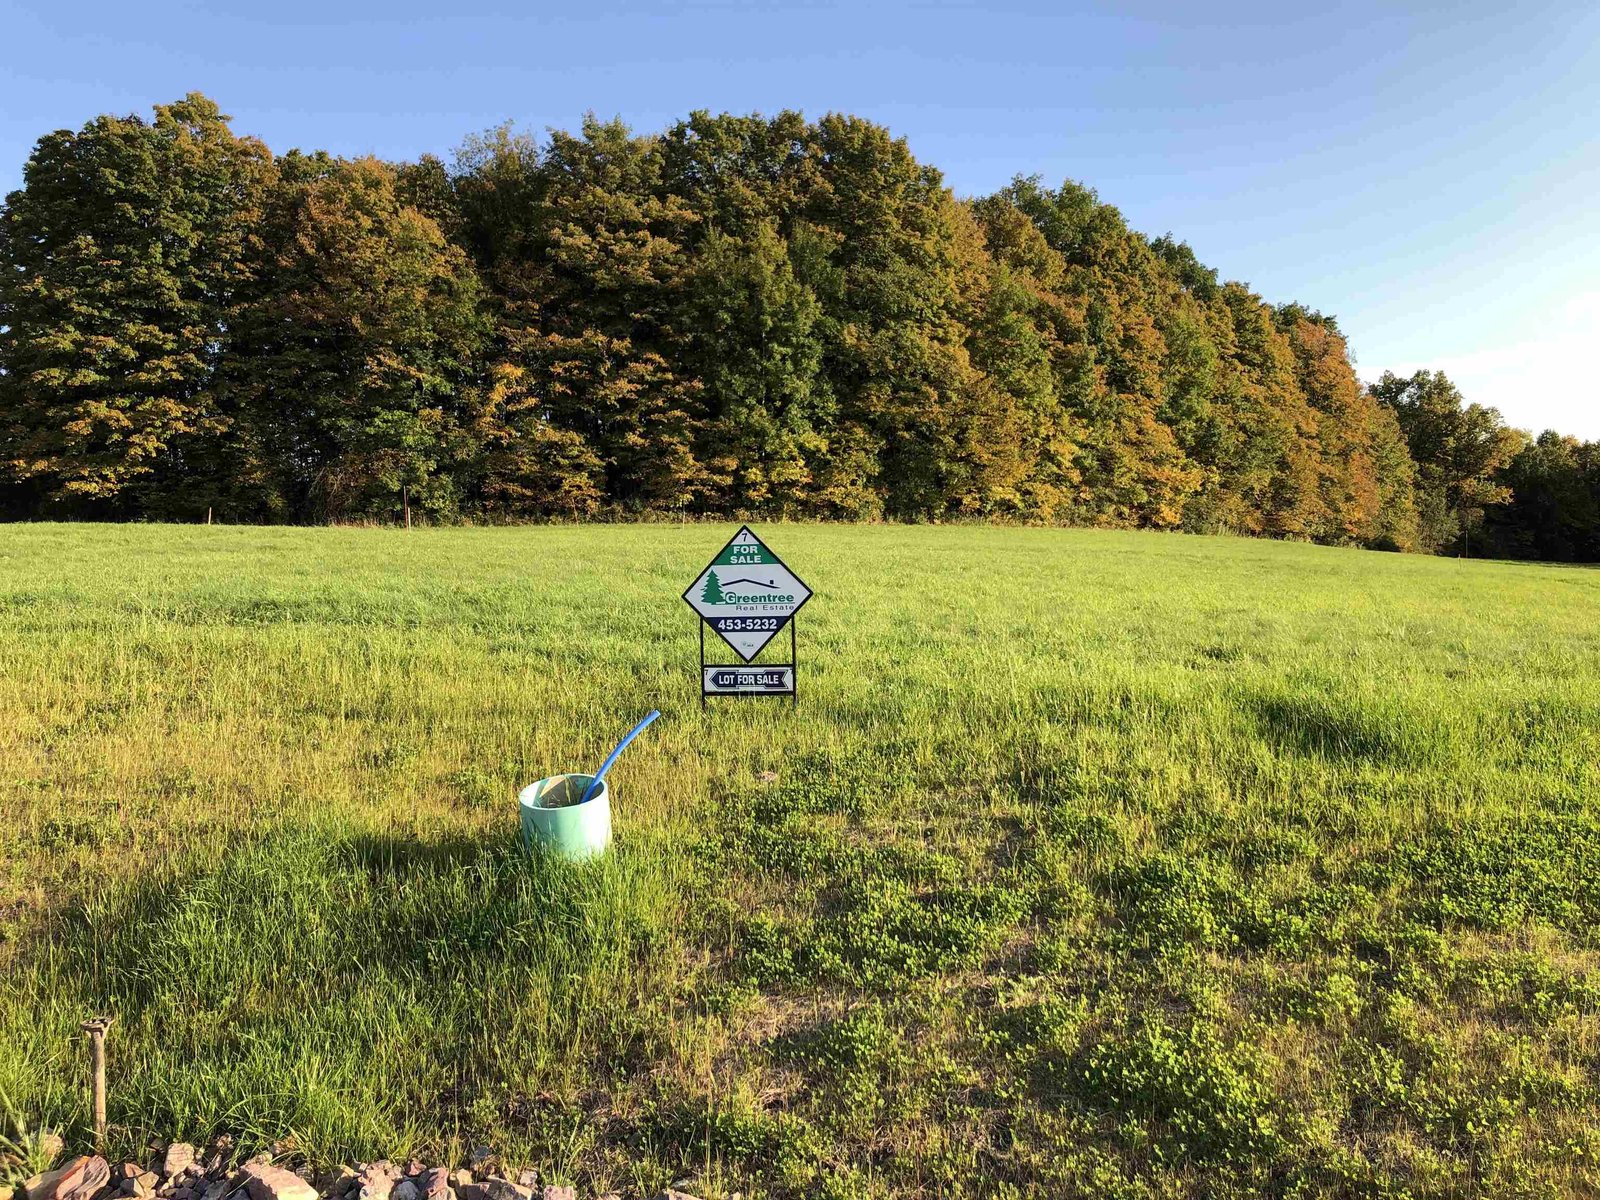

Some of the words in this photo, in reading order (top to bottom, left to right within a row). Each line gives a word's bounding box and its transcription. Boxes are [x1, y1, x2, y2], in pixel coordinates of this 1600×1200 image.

[742, 533, 748, 542] 7
[733, 545, 758, 554] FOR
[730, 555, 762, 564] SALE
[725, 591, 795, 604] Greentree
[718, 619, 777, 630] 453-5232
[718, 675, 735, 685] LOT
[737, 675, 755, 685] FOR
[756, 675, 779, 685] SALE
